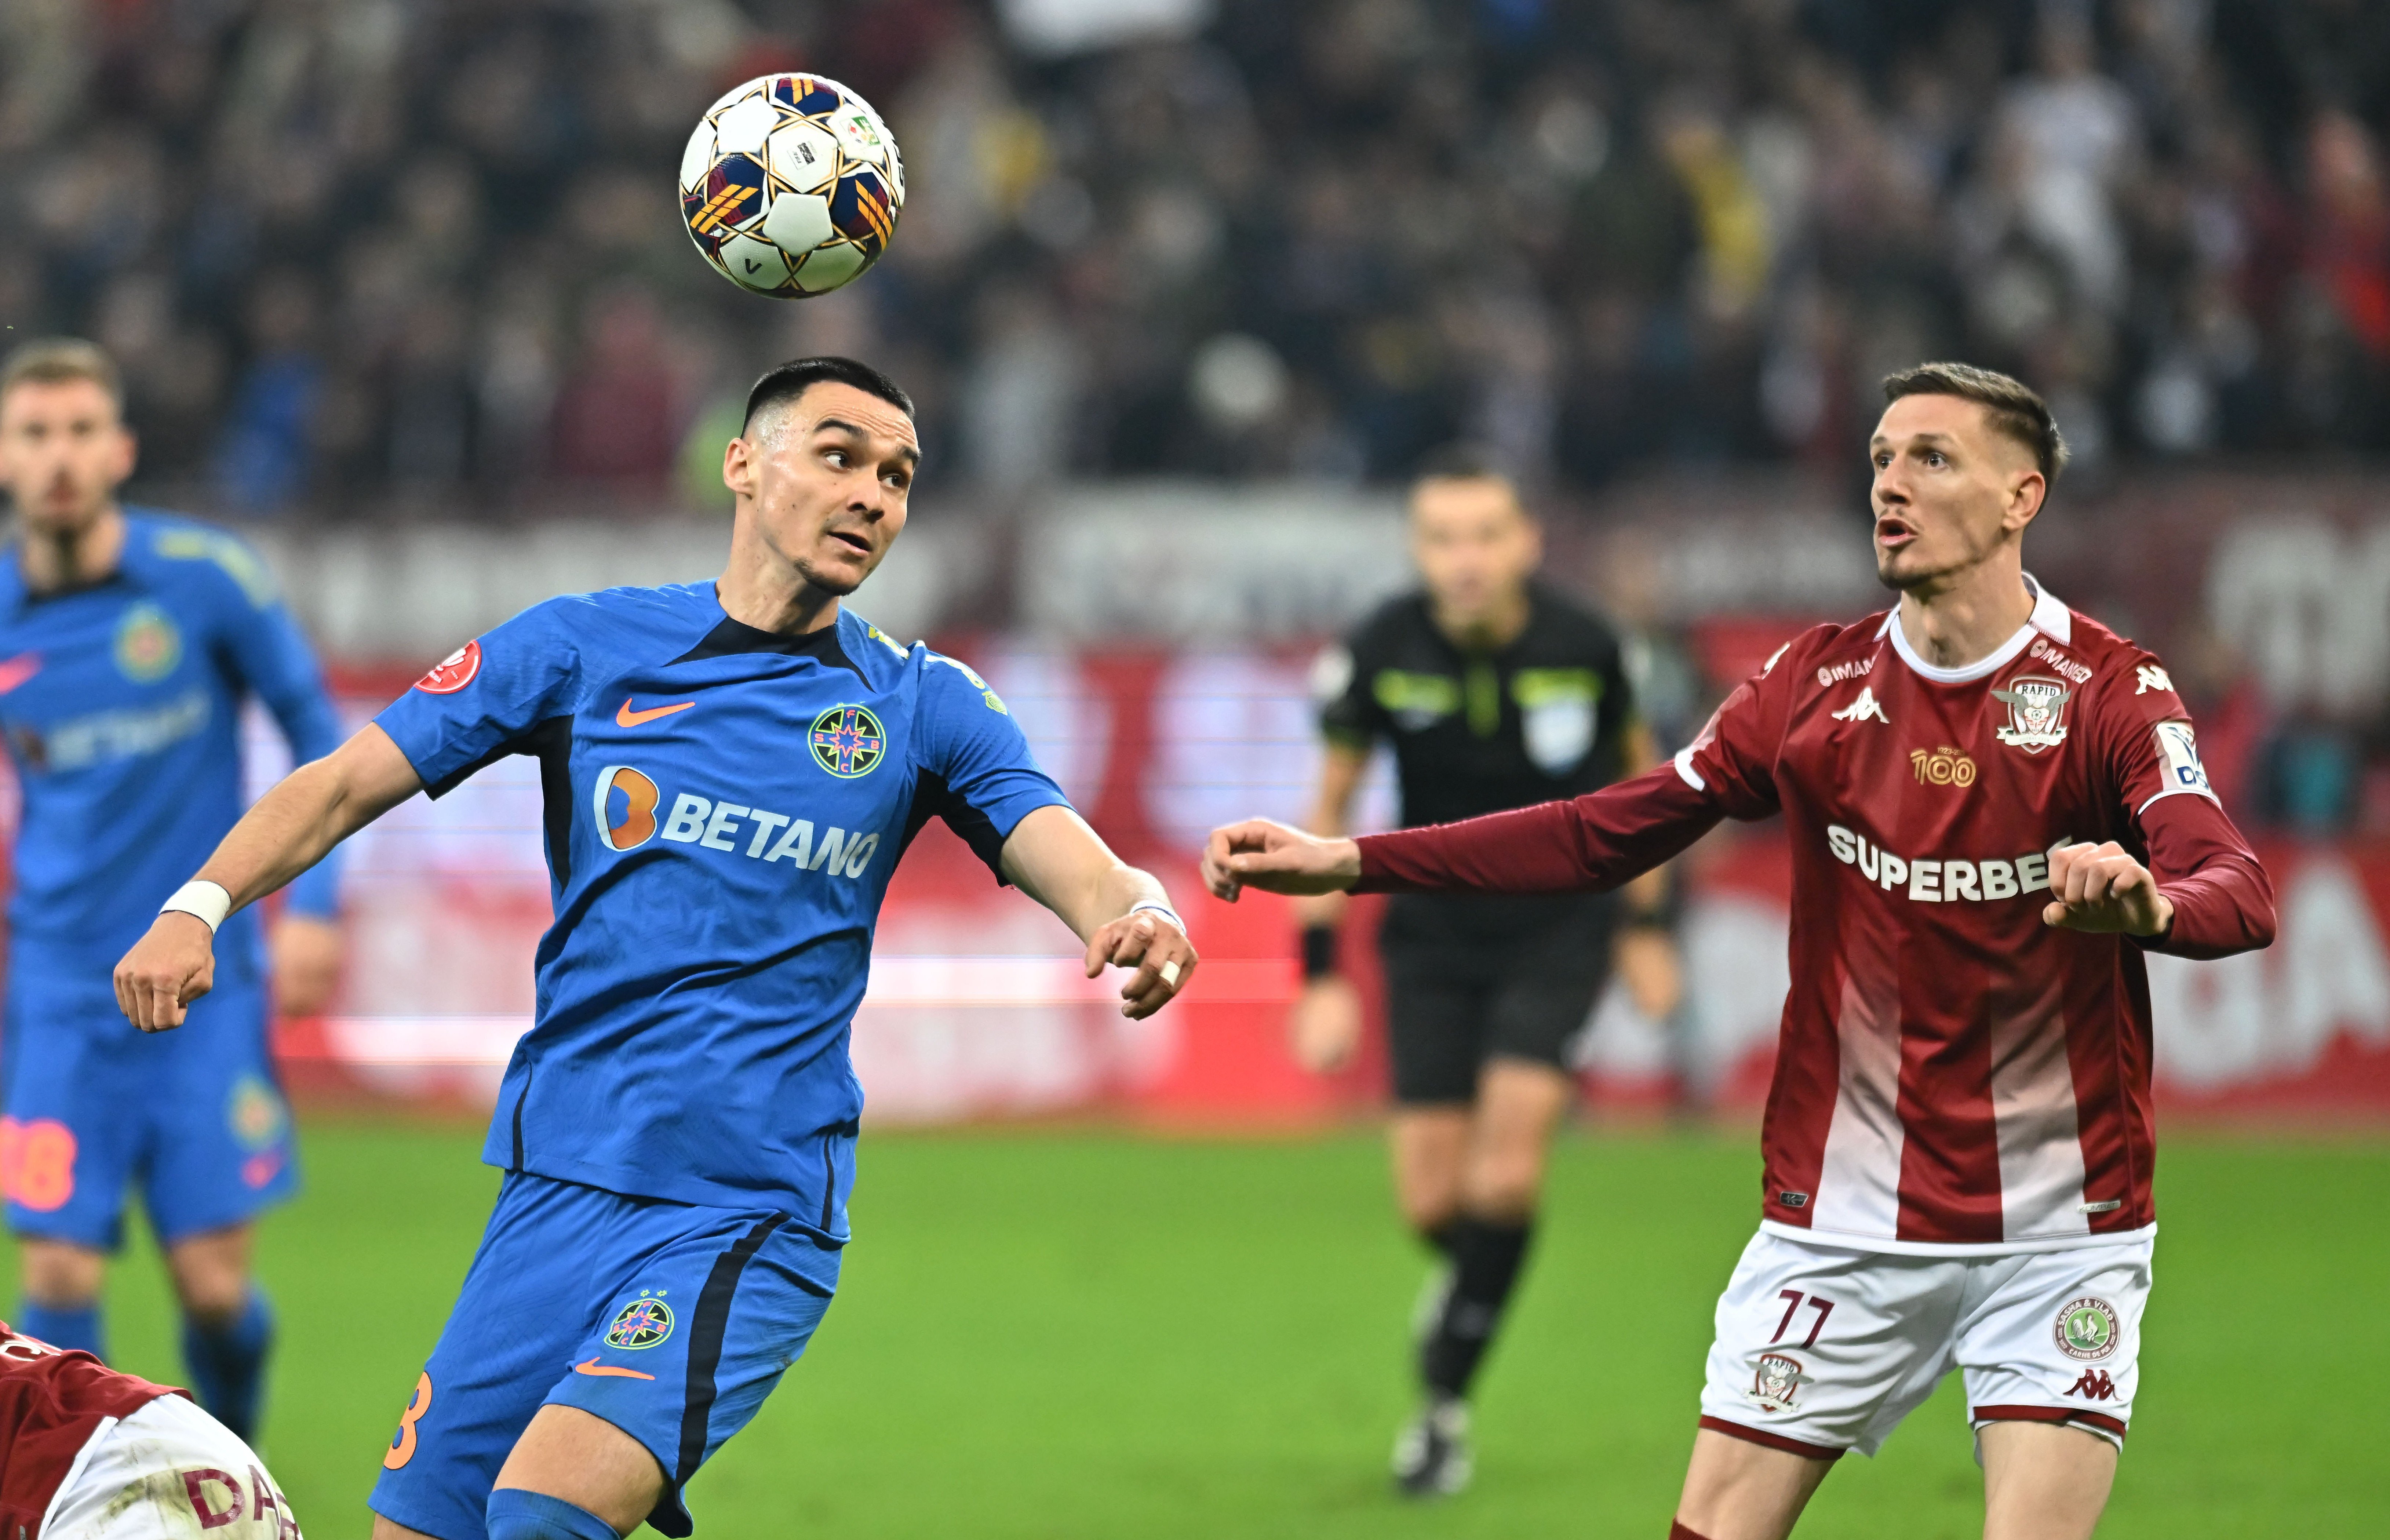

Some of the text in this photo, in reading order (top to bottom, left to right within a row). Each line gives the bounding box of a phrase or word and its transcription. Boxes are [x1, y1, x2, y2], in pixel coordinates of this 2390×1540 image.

[2021, 685, 2056, 696] RAPID
[846, 710, 856, 718] F
[815, 733, 824, 742] S
[871, 740, 879, 749] B
[841, 763, 849, 773] C
[1910, 750, 1976, 788] 100
[661, 793, 880, 878] BETANO
[1769, 1289, 1835, 1350] 77
[2058, 1301, 2082, 1326] SASHA
[2095, 1300, 2113, 1321] VLAD
[2069, 1348, 2091, 1358] CARNE
[2101, 1345, 2110, 1355] PUI
[1767, 1358, 1794, 1372] RAPID
